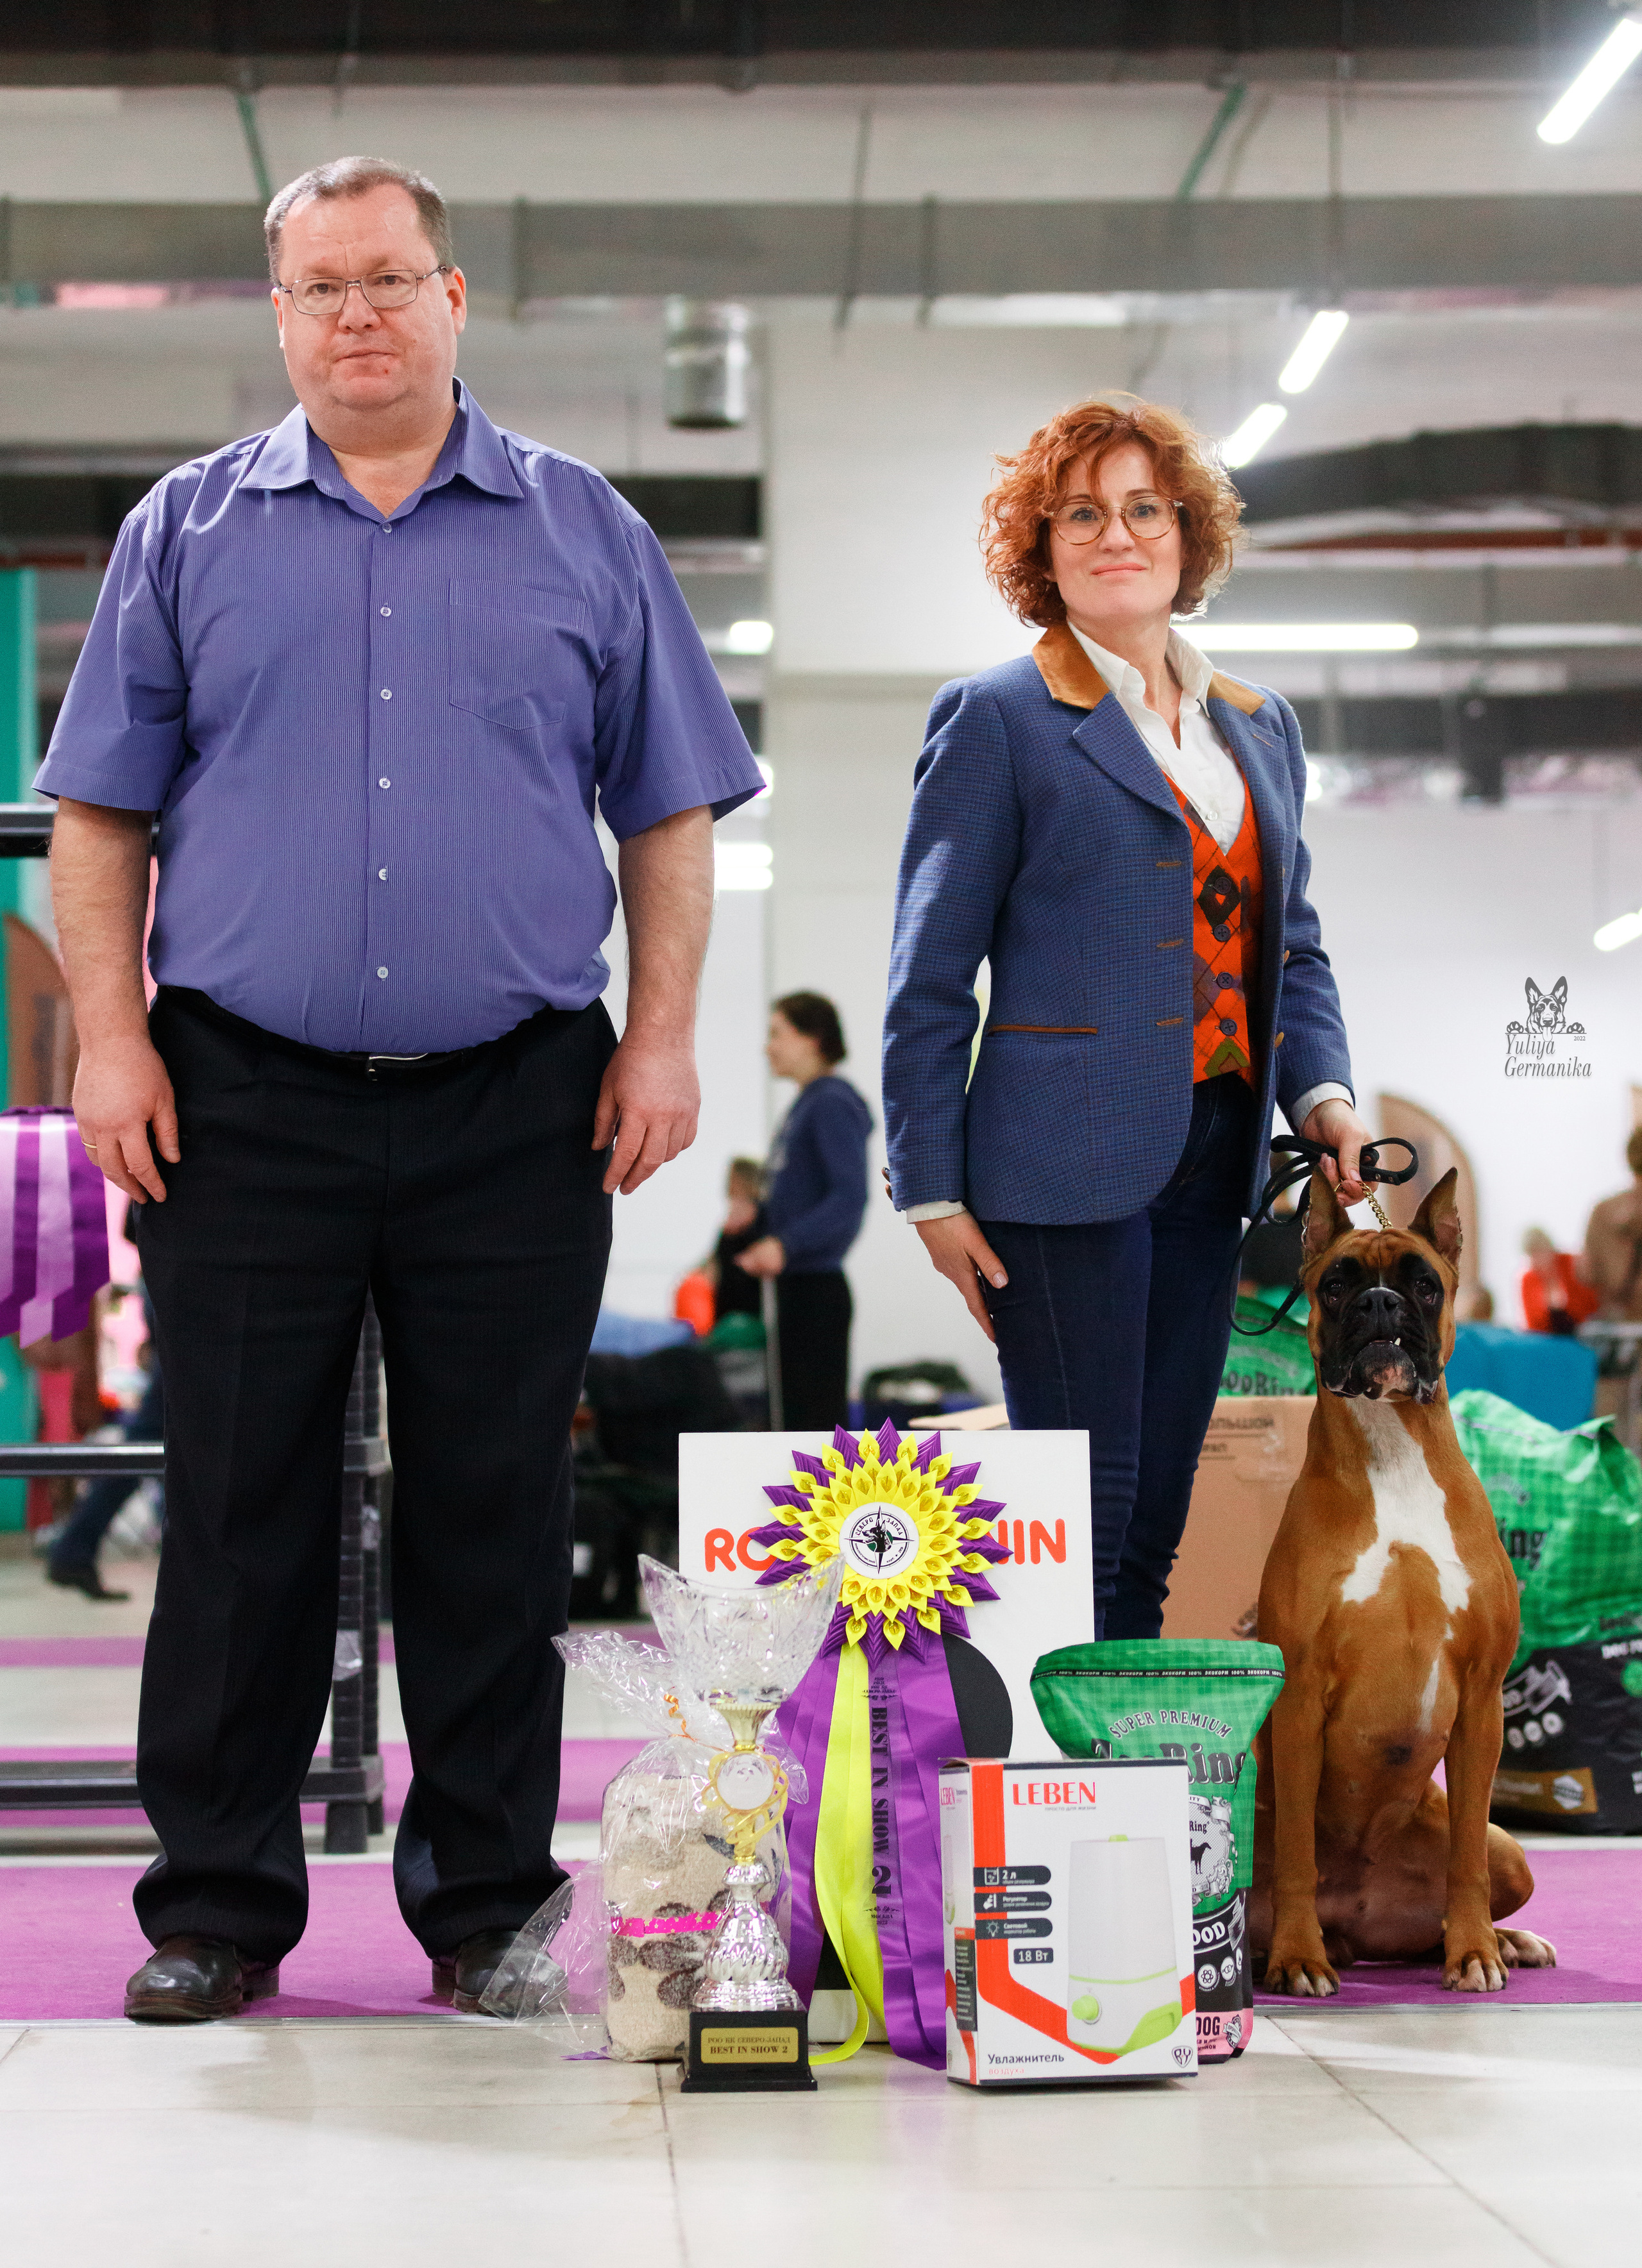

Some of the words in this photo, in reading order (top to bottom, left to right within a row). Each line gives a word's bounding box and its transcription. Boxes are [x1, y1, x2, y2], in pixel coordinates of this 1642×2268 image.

[855, 1517, 874, 1536] СЕВЕРО
[886, 1517, 904, 1536] ЗАПАД
[872, 1707, 888, 1756] BEST
[1108, 1710, 1156, 1739] SUPER
[1159, 1710, 1232, 1738] PREMIUM
[872, 1767, 888, 1788] IN
[1013, 1782, 1096, 1805] LEBEN
[873, 1798, 890, 1854] SHOW
[872, 1865, 892, 1895] 2
[1003, 1870, 1008, 1879] 2
[1193, 1921, 1226, 1946] OOD
[1019, 1950, 1032, 1962] 18
[1035, 1950, 1049, 1962] Вт
[710, 2046, 735, 2054] BEST
[750, 2045, 779, 2054] SHOW
[988, 2053, 1065, 2064] Увлажнитель
[988, 2067, 1024, 2077] воздуха
